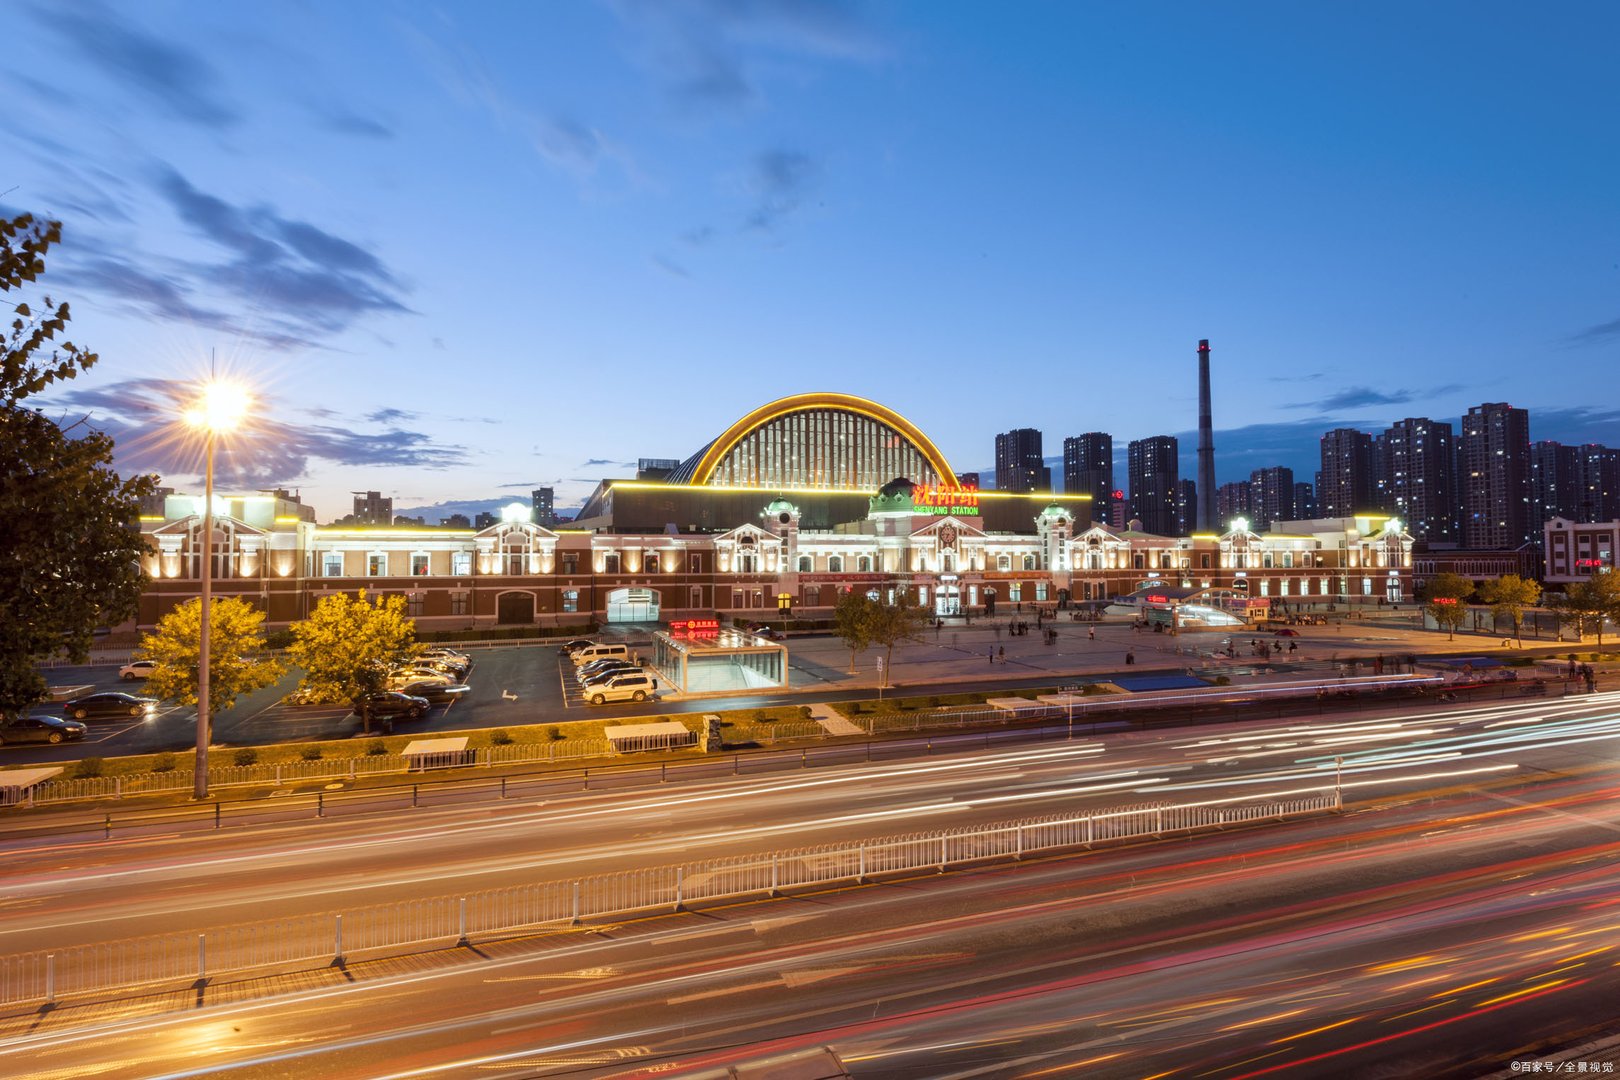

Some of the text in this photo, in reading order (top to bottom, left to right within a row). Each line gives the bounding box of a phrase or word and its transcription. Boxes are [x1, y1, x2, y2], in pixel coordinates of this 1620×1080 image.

[913, 484, 978, 505] 沈阳站
[913, 506, 979, 515] SHENYANG STATION
